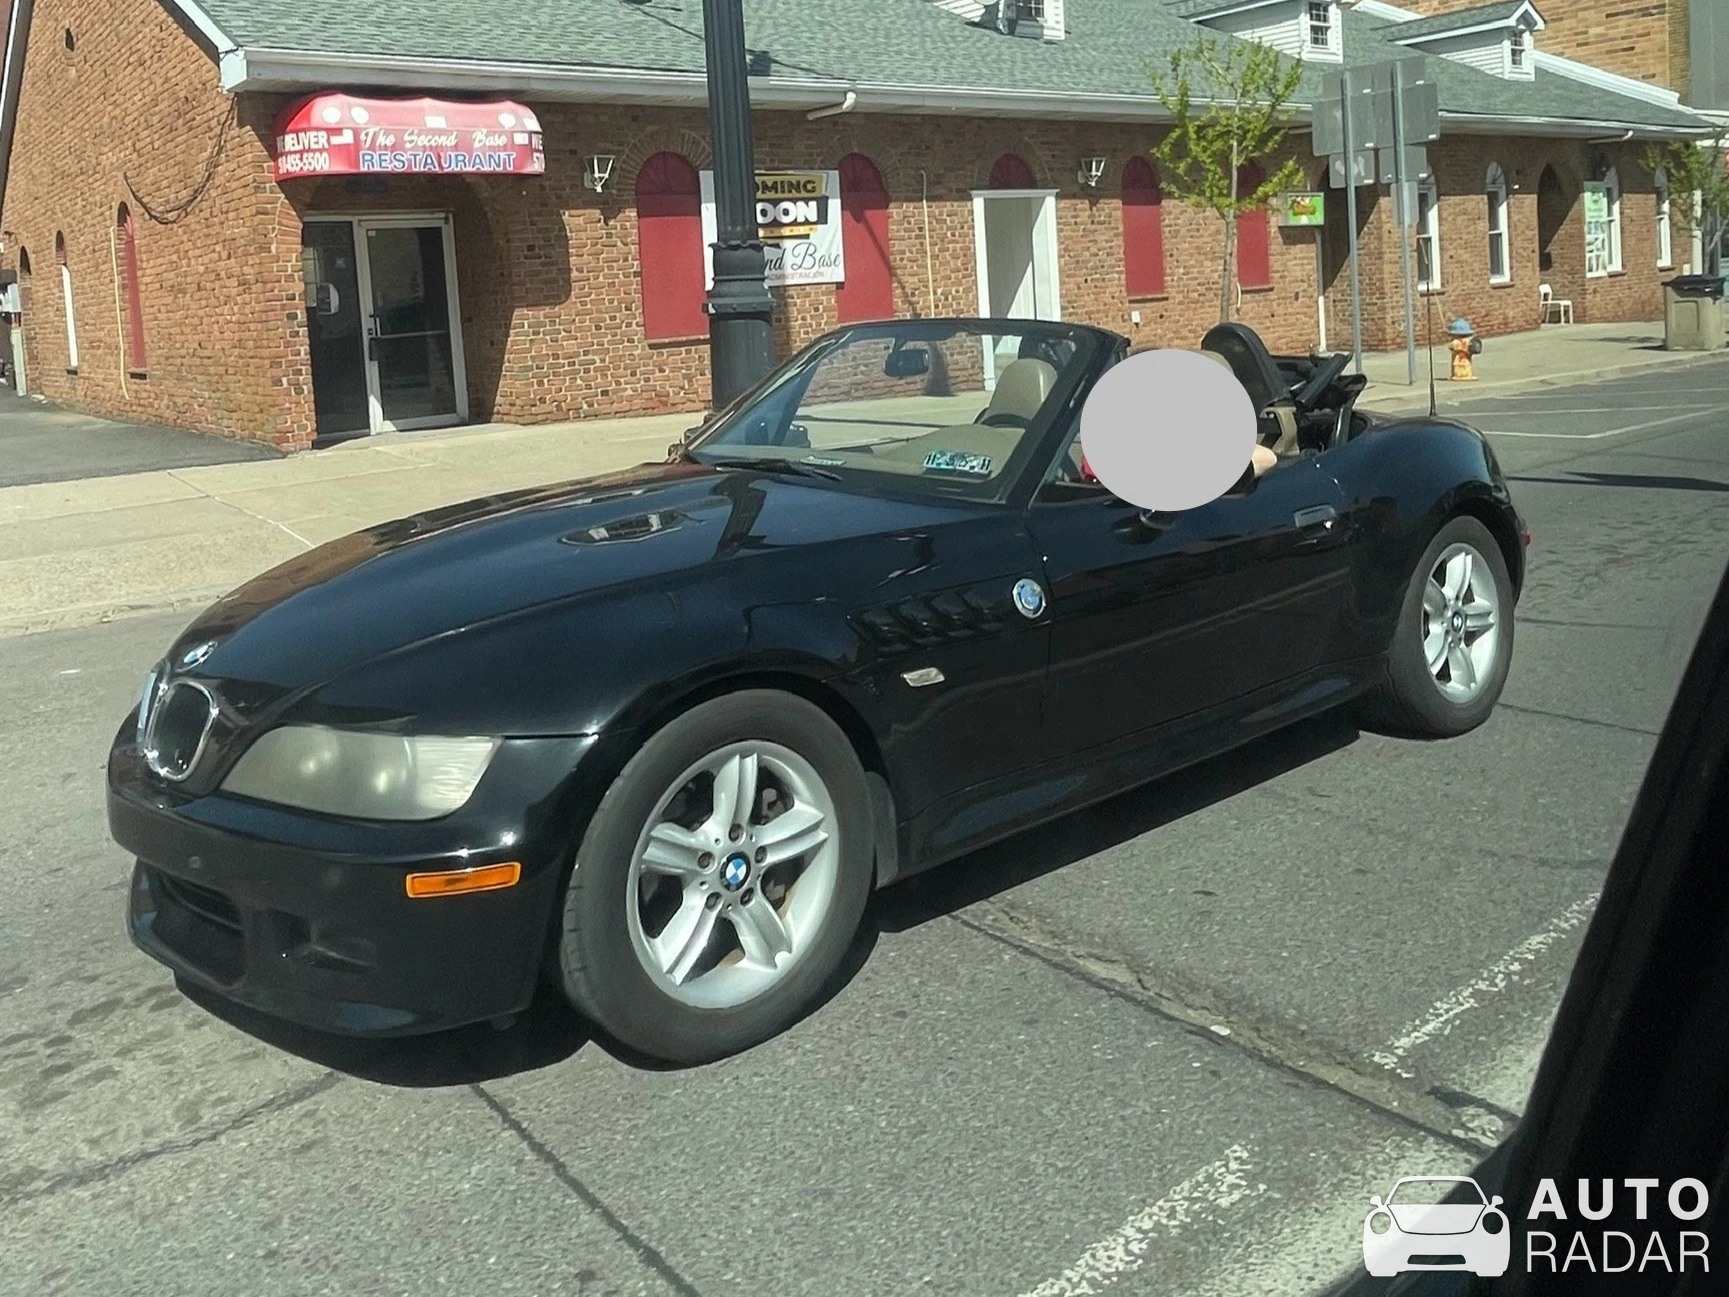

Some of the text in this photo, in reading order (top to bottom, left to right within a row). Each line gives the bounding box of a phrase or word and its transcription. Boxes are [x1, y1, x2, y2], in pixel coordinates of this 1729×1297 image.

[360, 127, 508, 149] The Second Base
[359, 151, 517, 172] RESTAURANT
[755, 180, 817, 194] MING
[755, 200, 818, 225] OON
[790, 241, 842, 271] Base
